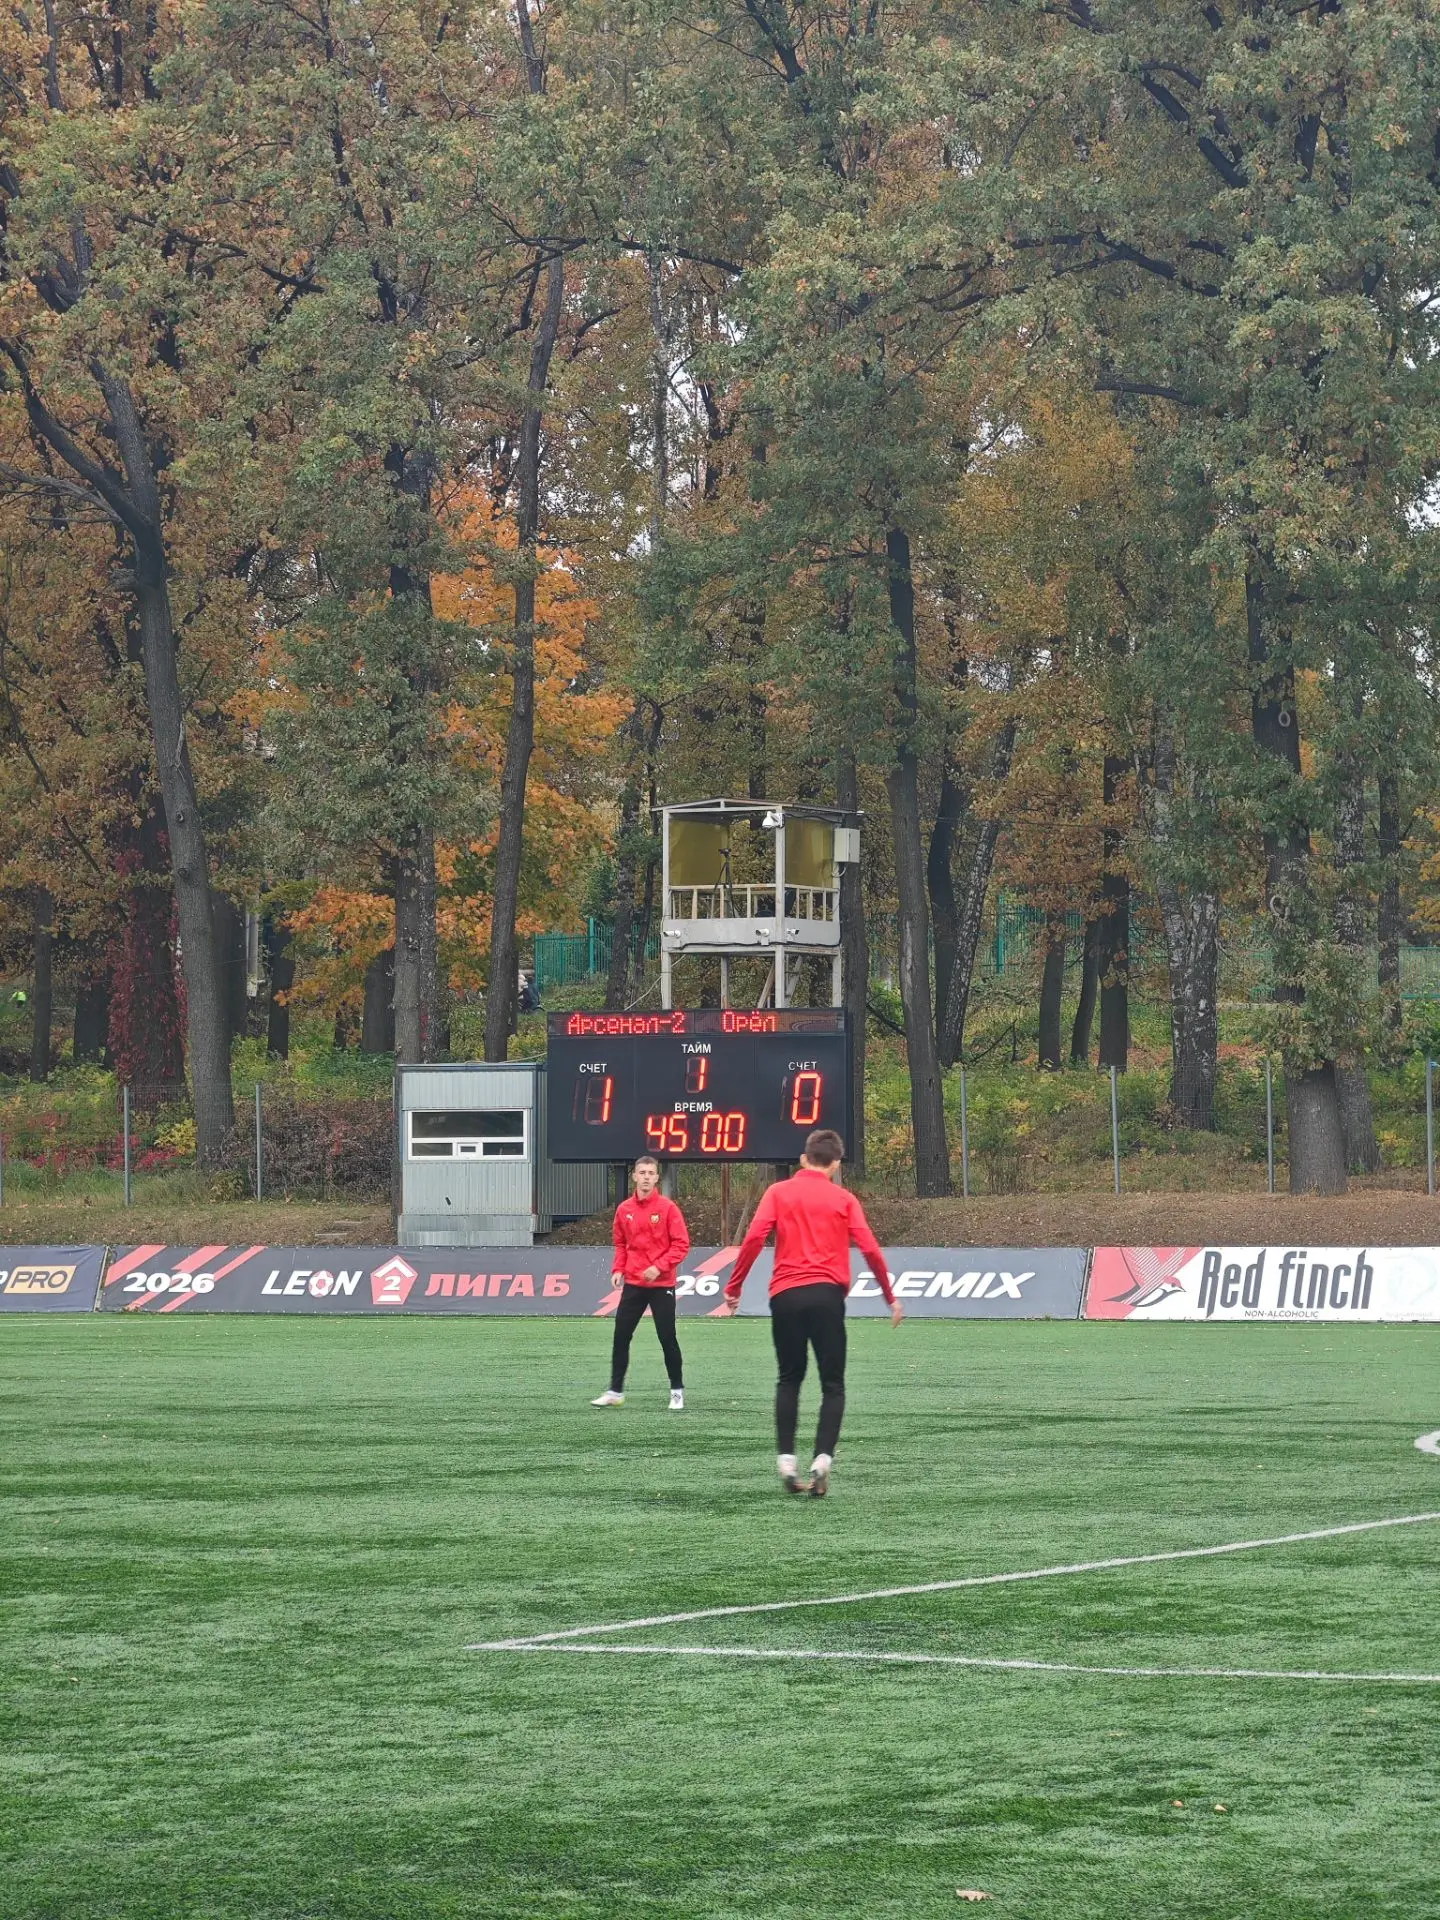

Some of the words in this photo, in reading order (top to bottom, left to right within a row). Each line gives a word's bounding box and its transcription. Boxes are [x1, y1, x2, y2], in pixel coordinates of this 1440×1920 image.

[568, 1012, 686, 1035] Арсенал-2
[721, 1011, 777, 1033] Орёл
[681, 1043, 712, 1054] ТАЙМ
[579, 1063, 608, 1074] СЧЕТ
[788, 1061, 818, 1071] СЧЕТ
[601, 1077, 613, 1122] 1
[674, 1102, 713, 1112] ВРЕМЯ
[791, 1072, 822, 1124] 0
[10, 1269, 68, 1288] PRO
[123, 1272, 215, 1293] 2026
[261, 1270, 363, 1298] LEON
[382, 1275, 401, 1291] 2
[424, 1273, 535, 1297] ЛИГА
[542, 1273, 570, 1297] Б
[675, 1275, 720, 1297] 26
[848, 1271, 1036, 1299] DEMIX
[1197, 1248, 1267, 1319] Red
[1278, 1248, 1374, 1310] finch
[1244, 1310, 1320, 1319] NON-ALCOHOLIC
